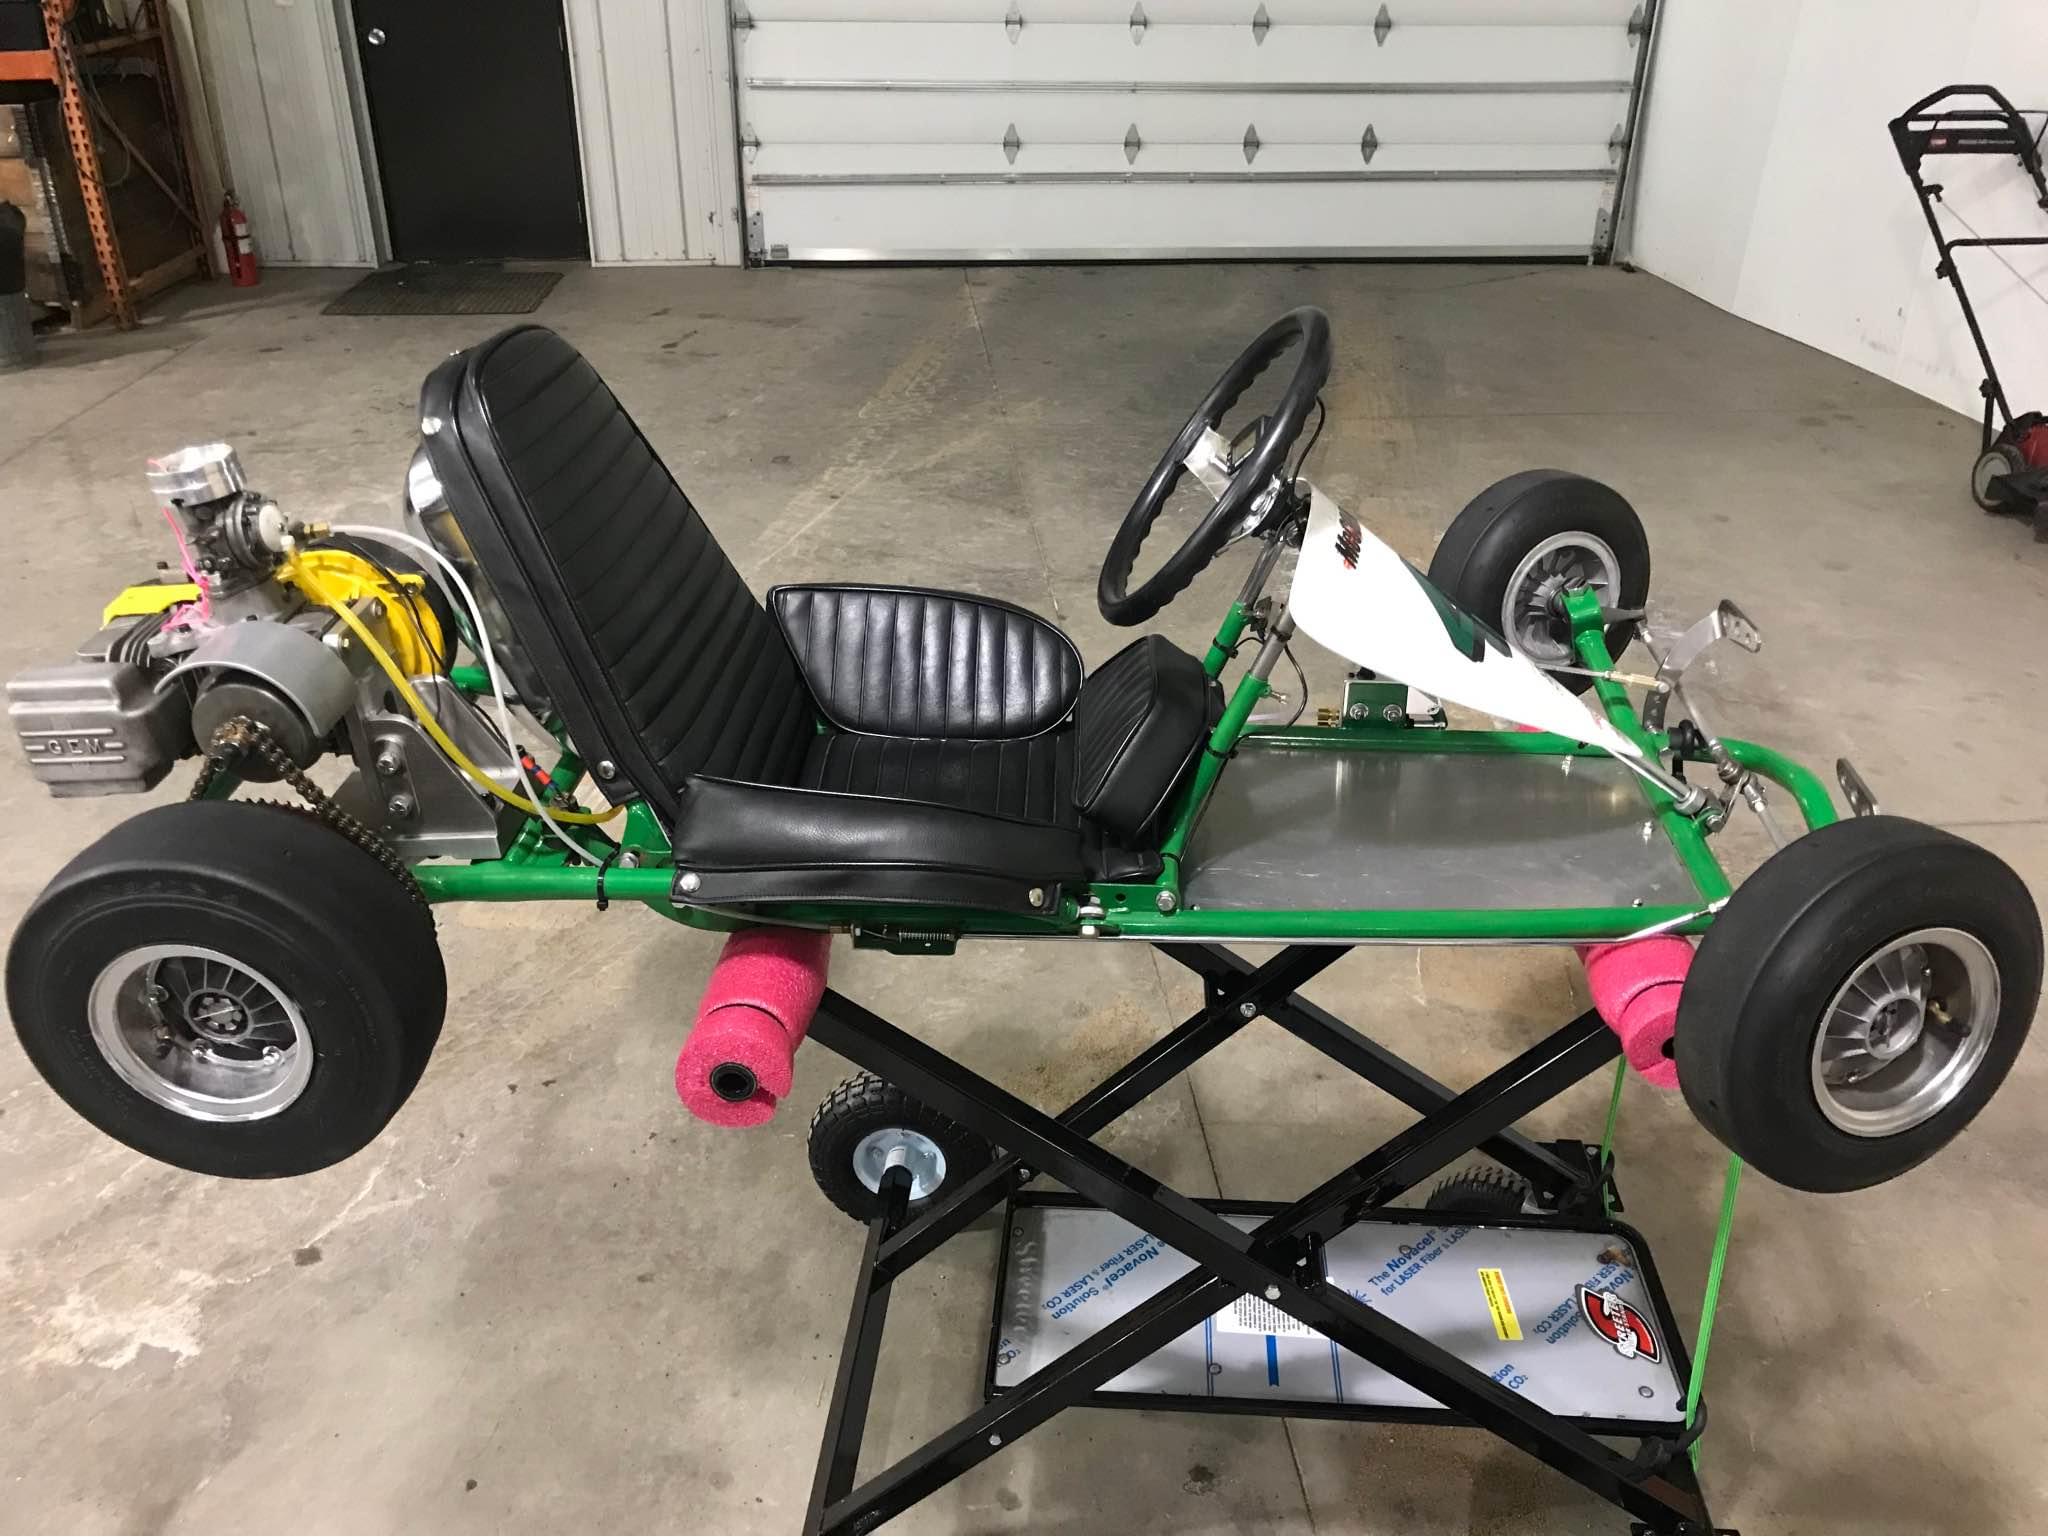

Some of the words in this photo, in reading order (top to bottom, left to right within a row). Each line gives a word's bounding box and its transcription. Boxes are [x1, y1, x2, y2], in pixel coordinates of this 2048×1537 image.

[48, 738, 101, 754] GEM
[1126, 1233, 1154, 1256] LASER
[1099, 1251, 1125, 1272] Fiber
[1380, 1282, 1396, 1296] for
[1394, 1262, 1423, 1286] LASER
[1420, 1246, 1443, 1265] Fiber
[1064, 1274, 1094, 1298] LASER
[1368, 1271, 1390, 1286] The
[1051, 1288, 1100, 1319] Solution
